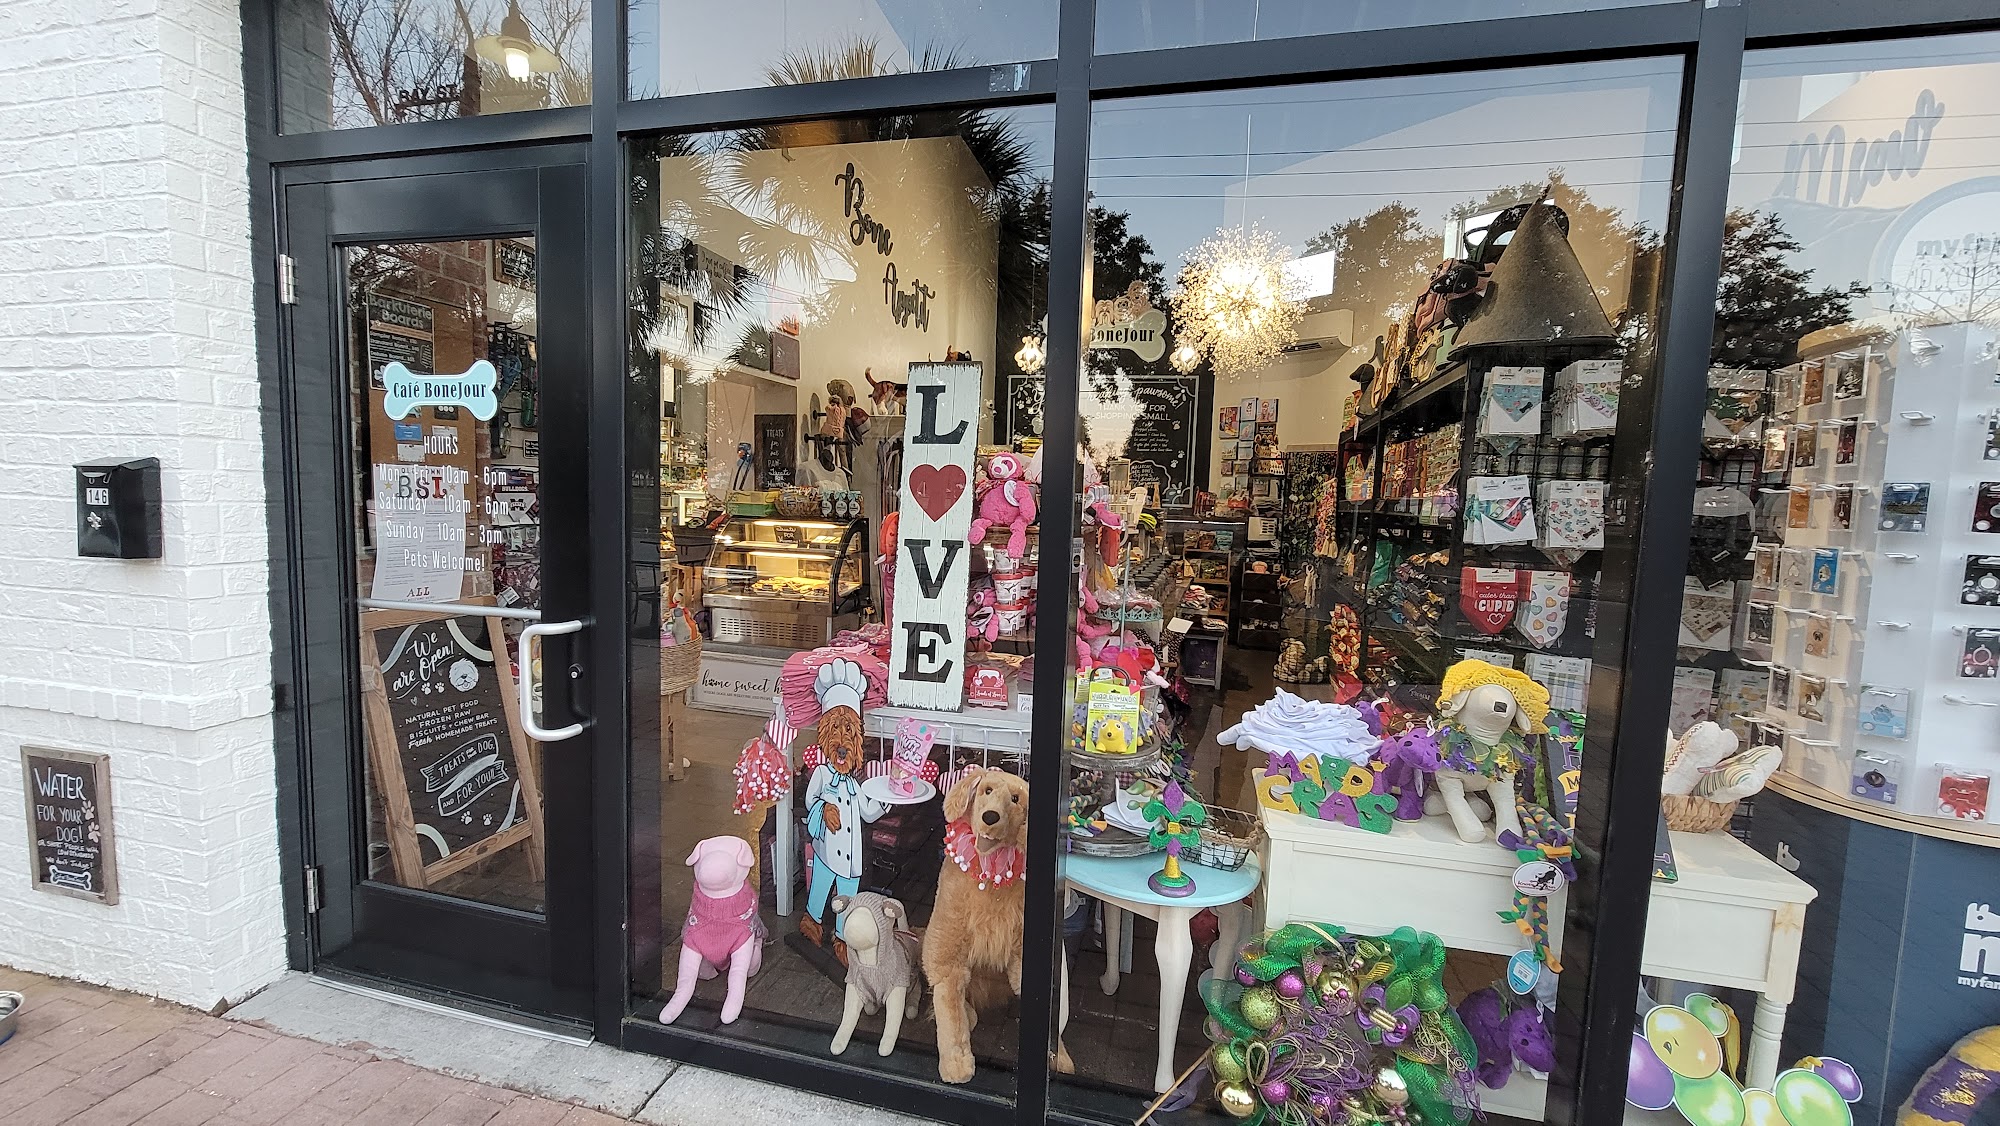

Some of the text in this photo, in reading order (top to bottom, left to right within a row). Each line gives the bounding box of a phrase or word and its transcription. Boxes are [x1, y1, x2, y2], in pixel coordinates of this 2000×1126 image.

[835, 163, 893, 257] Bone
[382, 308, 424, 329] Boards
[394, 381, 486, 399] Café BoneJour
[1134, 386, 1184, 410] pawsome!
[1095, 412, 1171, 421] SHOPPING SMALL
[1149, 404, 1166, 412] FOR
[424, 436, 458, 455] HOURS
[766, 429, 784, 438] TREATS
[379, 463, 399, 481] Mon
[414, 465, 428, 483] Fri
[441, 465, 469, 484] 10am
[483, 466, 507, 491] 6pm
[396, 475, 448, 499] BSL
[89, 490, 107, 504] 146
[379, 492, 427, 514] Saturday
[443, 495, 471, 513] 10am
[485, 496, 509, 519] 6pm
[386, 520, 424, 543] Sunday
[437, 522, 464, 541] 10am
[479, 525, 502, 547] 3pm
[404, 549, 485, 572] Pets Welcome!
[406, 586, 430, 598] ALL
[1478, 600, 1515, 612] CUPID
[406, 632, 438, 658] We
[420, 641, 455, 681] Open!
[392, 670, 416, 691] are
[701, 669, 731, 689] hme
[733, 679, 771, 692] sweet
[405, 699, 479, 724] NATURAL PET FOOD
[419, 709, 471, 729] FROZEN RAW
[408, 718, 498, 750] Fresh HOMEMADE TREATS
[409, 712, 489, 740] BISCUITS CHEW BAR
[438, 751, 466, 777] TREATS
[1264, 750, 1390, 797] MARDI
[34, 767, 86, 800] WATER
[442, 798, 455, 808] AND
[456, 783, 475, 804] FOR
[36, 804, 83, 825] FOR YOUR
[1256, 774, 1399, 835] GRAS
[56, 826, 84, 843] DOG!
